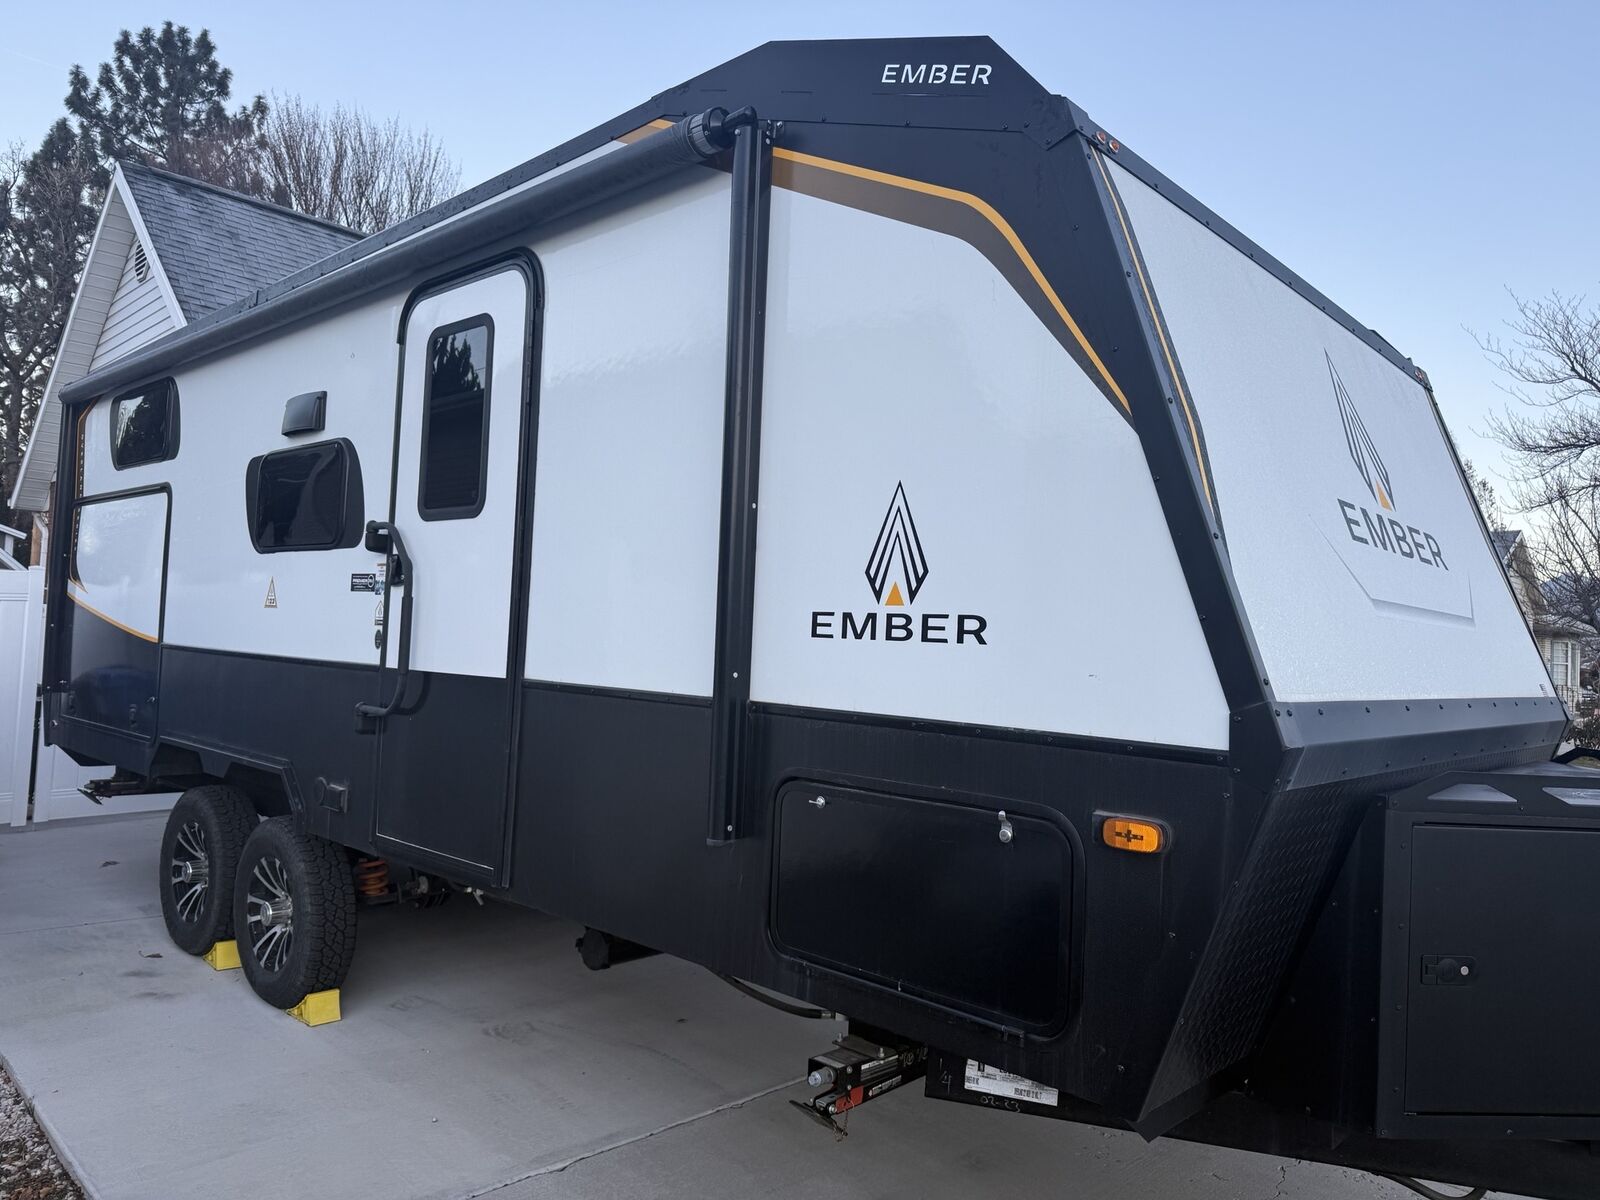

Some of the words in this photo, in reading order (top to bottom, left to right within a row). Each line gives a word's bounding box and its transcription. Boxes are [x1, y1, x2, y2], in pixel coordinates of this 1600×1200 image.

[881, 64, 993, 85] EMBER
[1337, 498, 1449, 571] EMBER
[811, 611, 988, 646] EMBER
